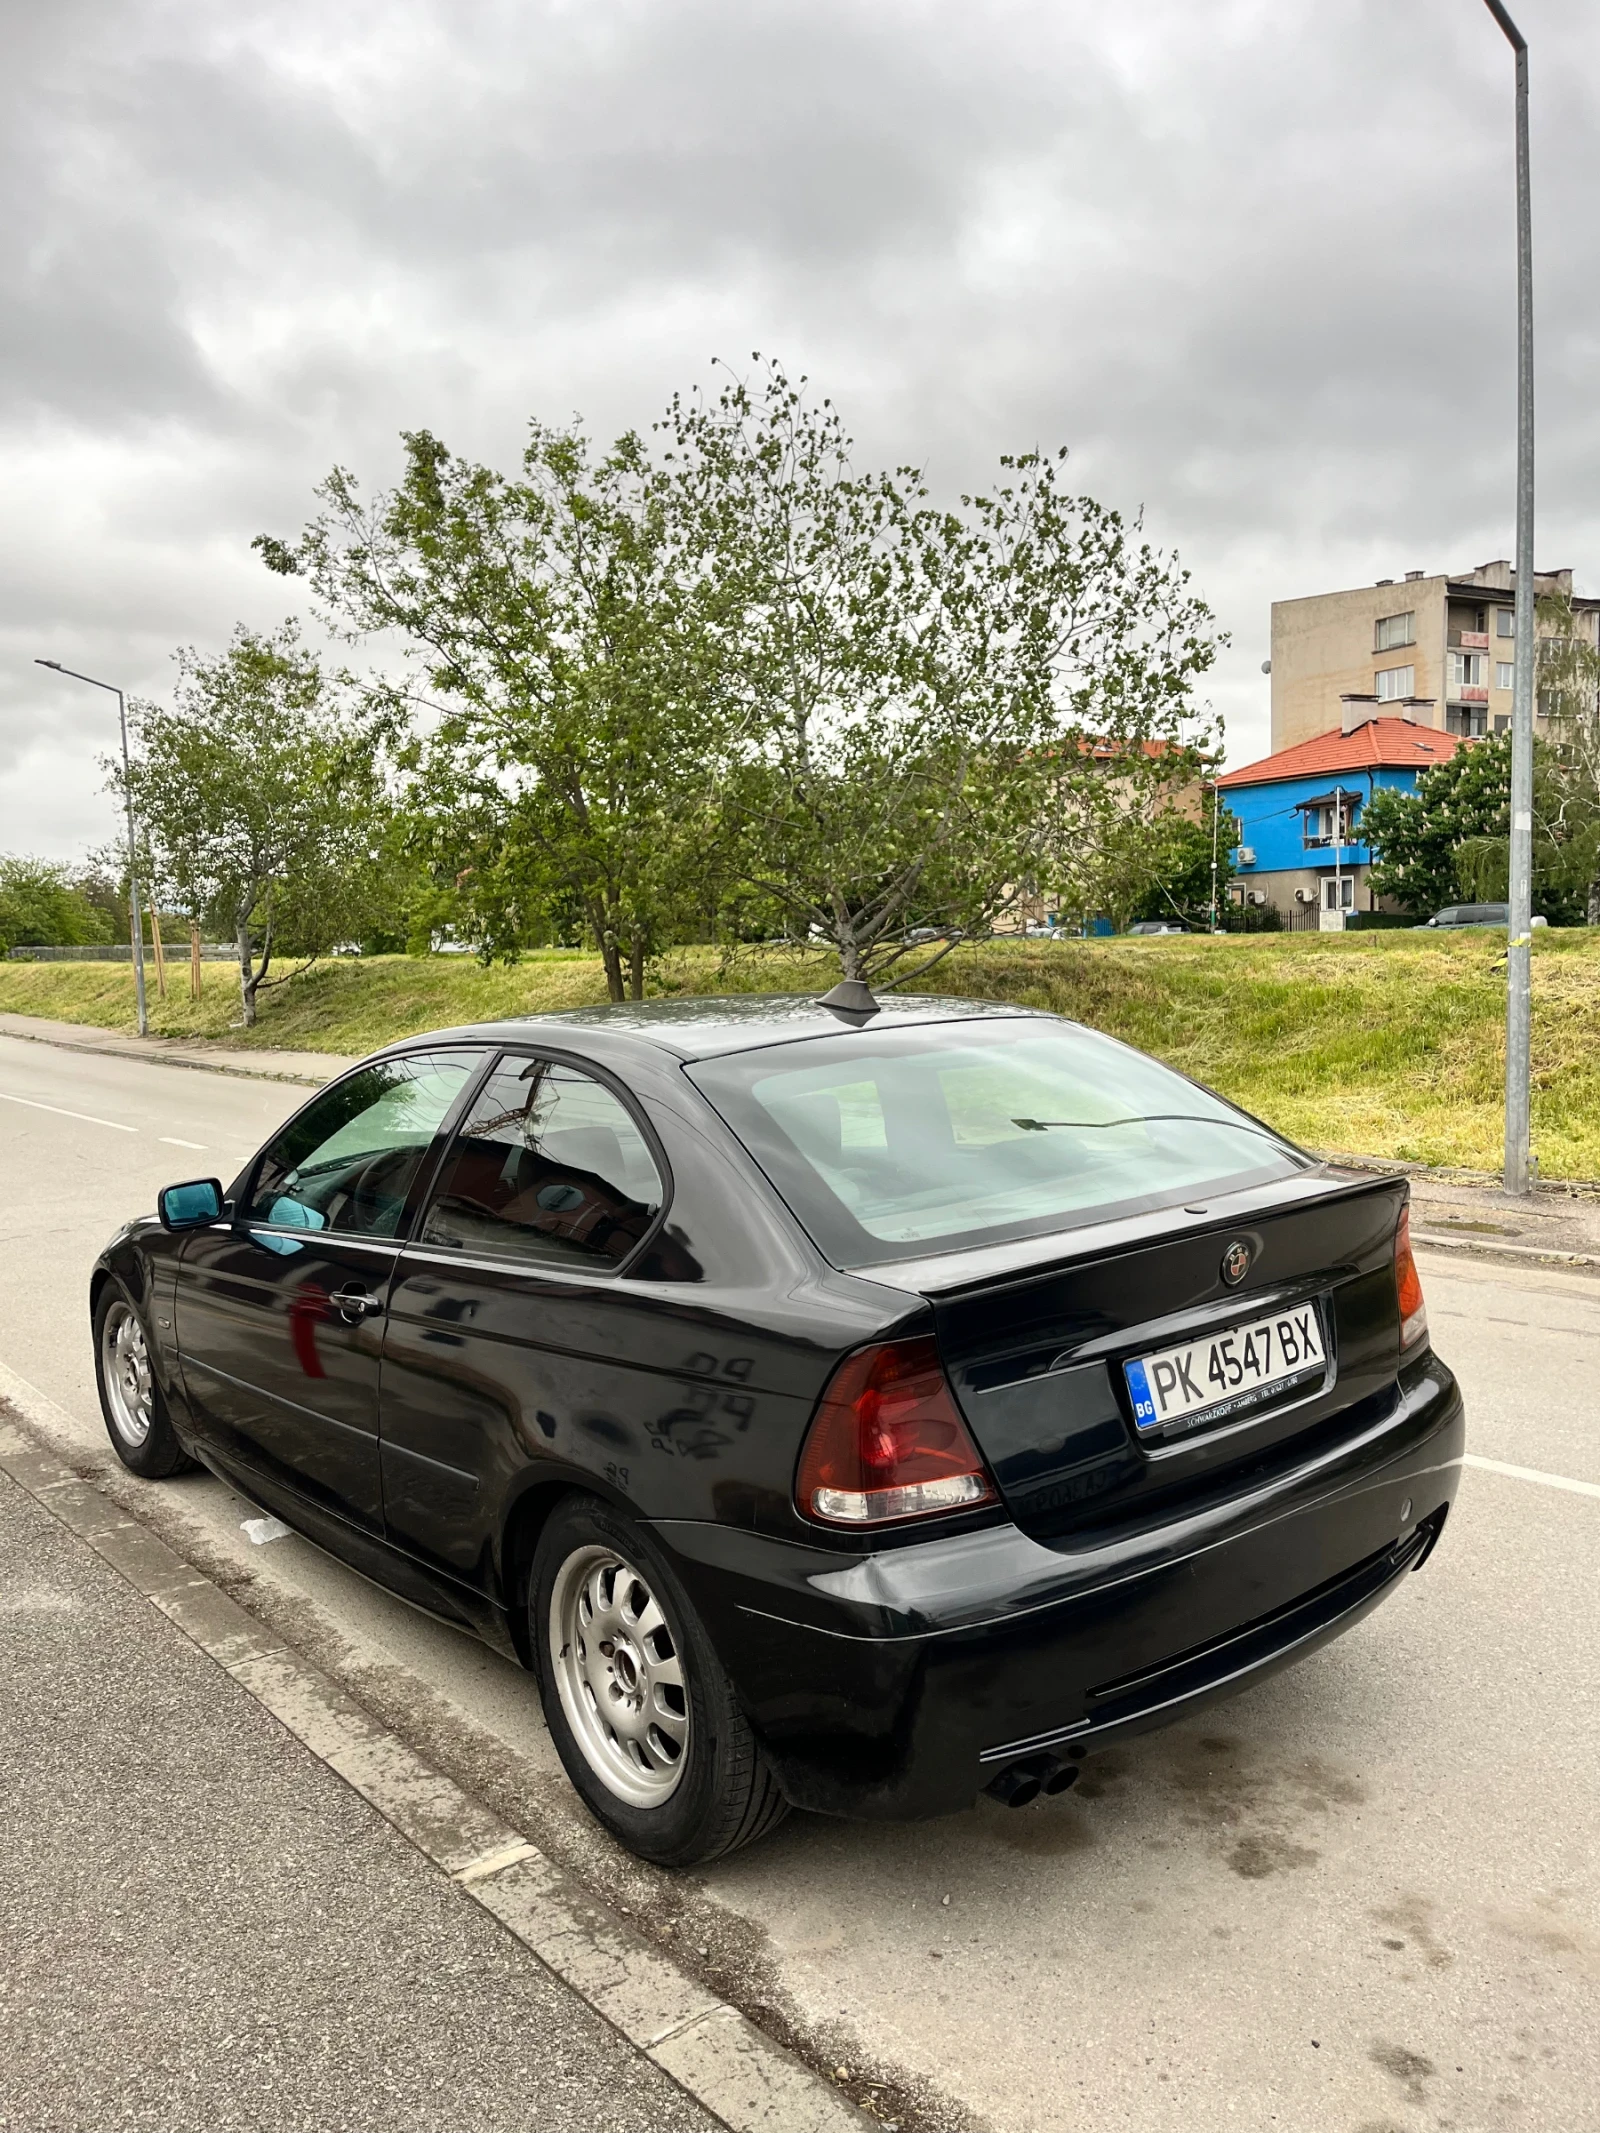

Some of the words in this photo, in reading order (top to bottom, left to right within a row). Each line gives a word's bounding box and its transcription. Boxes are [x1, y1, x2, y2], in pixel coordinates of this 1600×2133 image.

[1151, 1351, 1204, 1411] PK
[1208, 1326, 1271, 1390] 4547
[1276, 1313, 1318, 1366] BX
[1136, 1400, 1153, 1418] BG
[1187, 1404, 1232, 1428] SCHWARZKOPF
